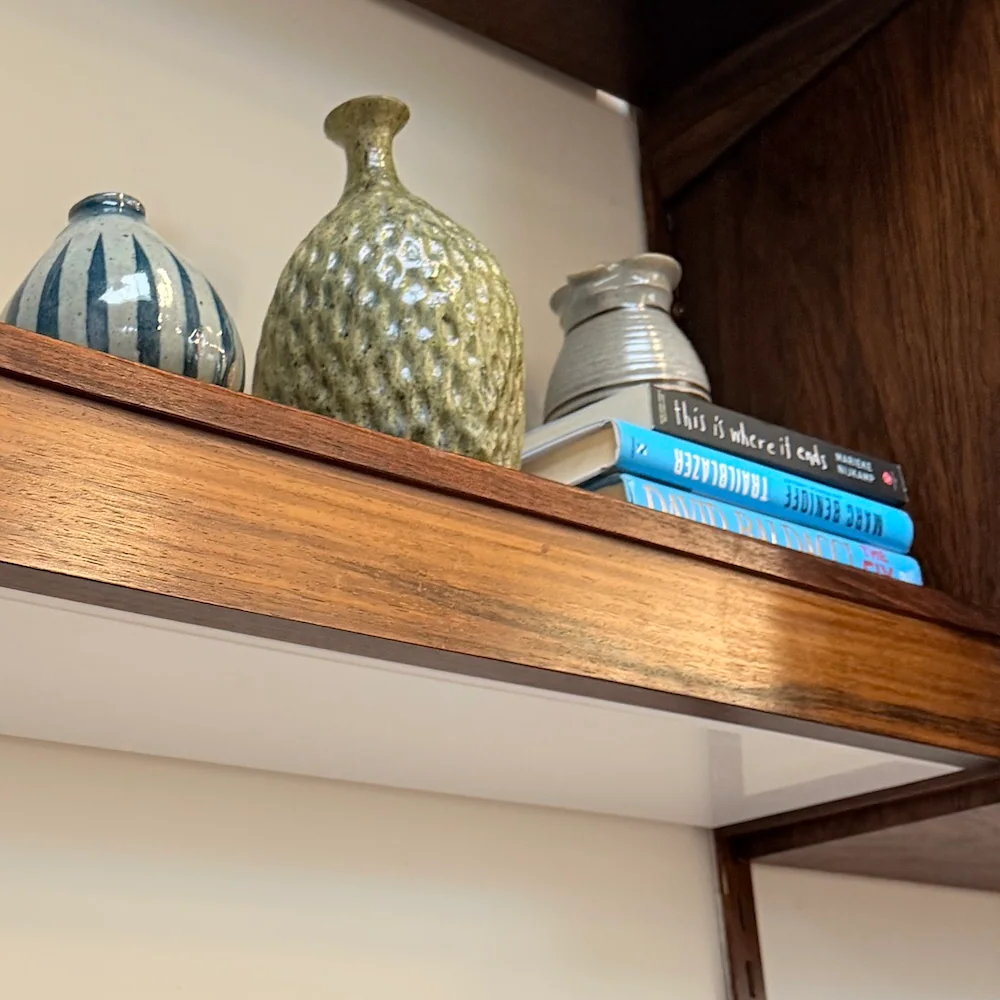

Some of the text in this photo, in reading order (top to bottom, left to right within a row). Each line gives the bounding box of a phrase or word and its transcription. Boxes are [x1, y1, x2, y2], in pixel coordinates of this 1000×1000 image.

[673, 399, 707, 432] this
[713, 415, 726, 440] is
[729, 421, 777, 456] where
[796, 444, 828, 471] ends
[673, 448, 769, 502] TRAILBLAZER
[783, 484, 840, 524] BENIOFF
[845, 503, 883, 537] MARC
